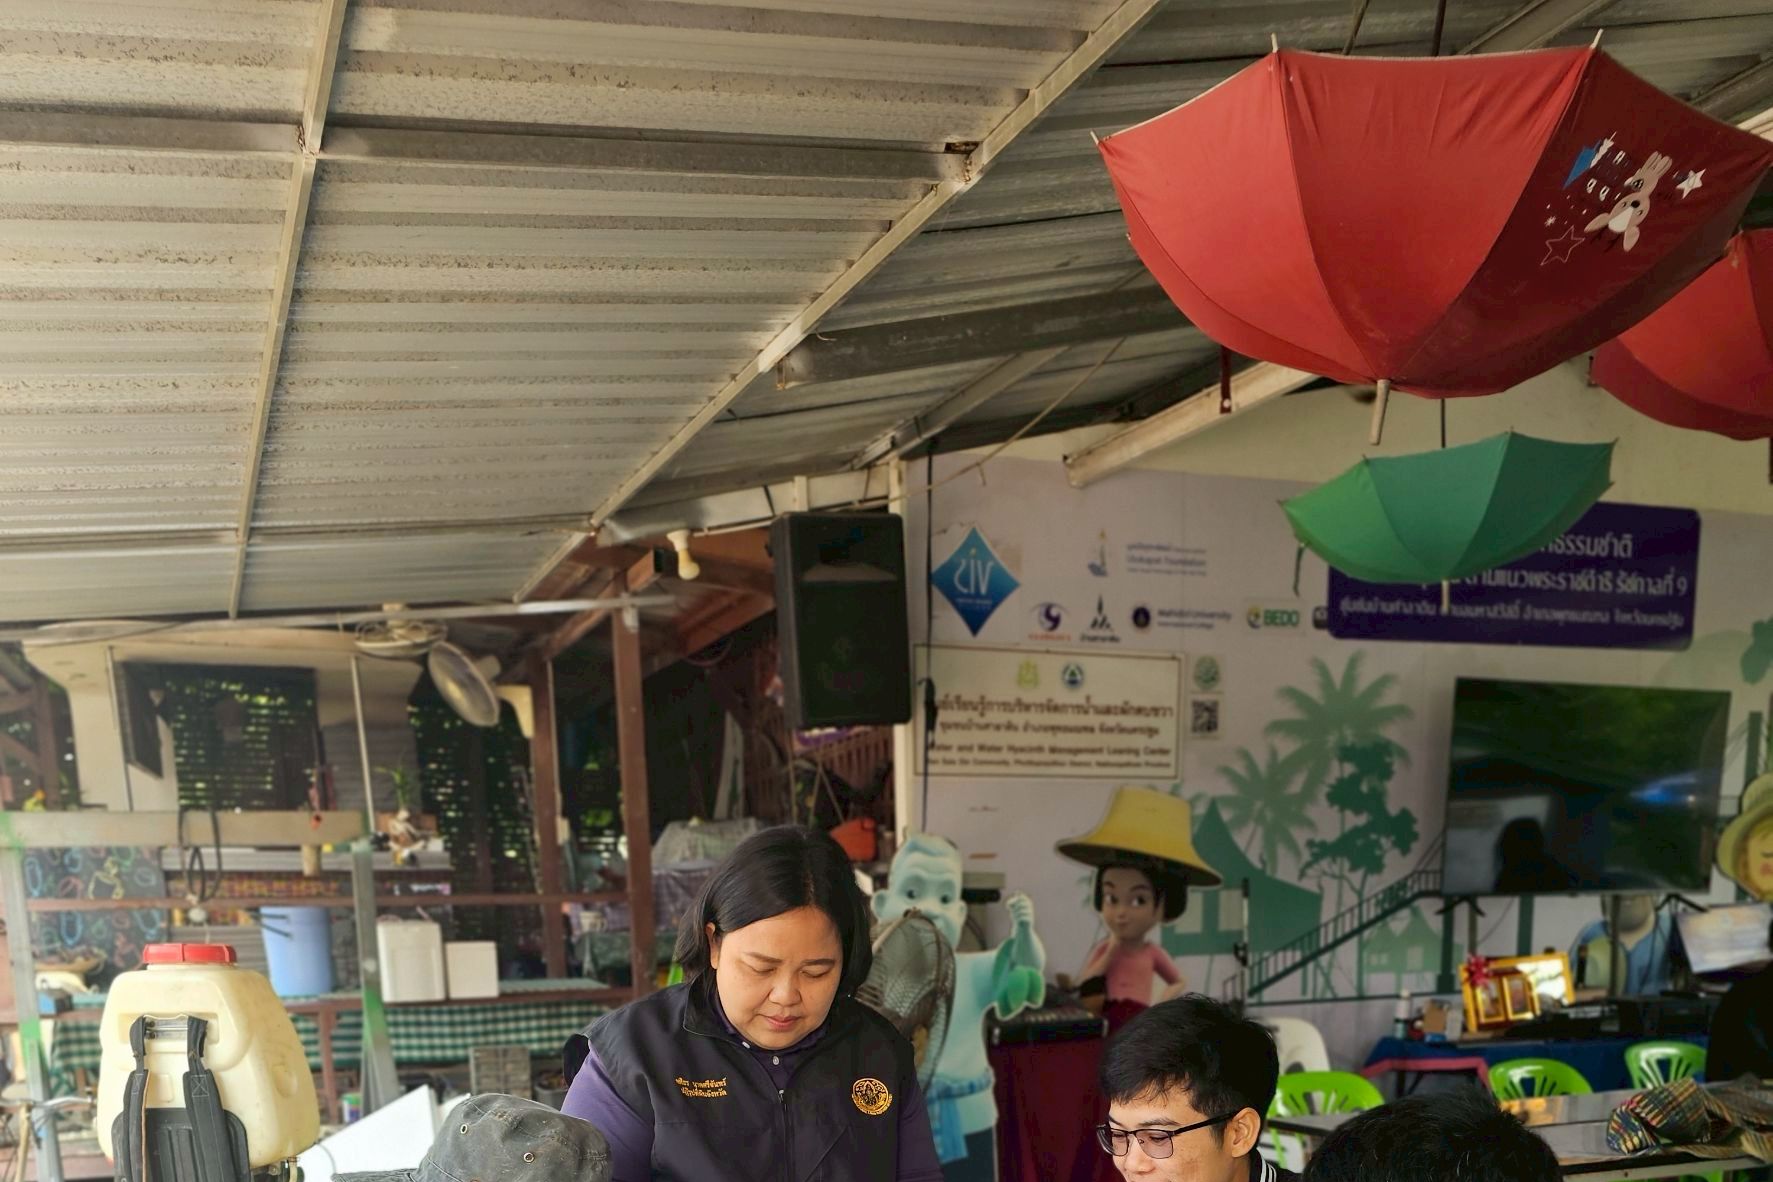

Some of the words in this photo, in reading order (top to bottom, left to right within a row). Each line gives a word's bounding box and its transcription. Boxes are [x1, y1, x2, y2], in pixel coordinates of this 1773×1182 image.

[1540, 532, 1632, 558] ธรรมชาติ
[1677, 577, 1687, 595] 9
[1192, 610, 1232, 621] University
[1264, 610, 1299, 628] BEDO
[957, 744, 974, 752] and
[977, 744, 1003, 753] Water
[1143, 746, 1171, 756] Center
